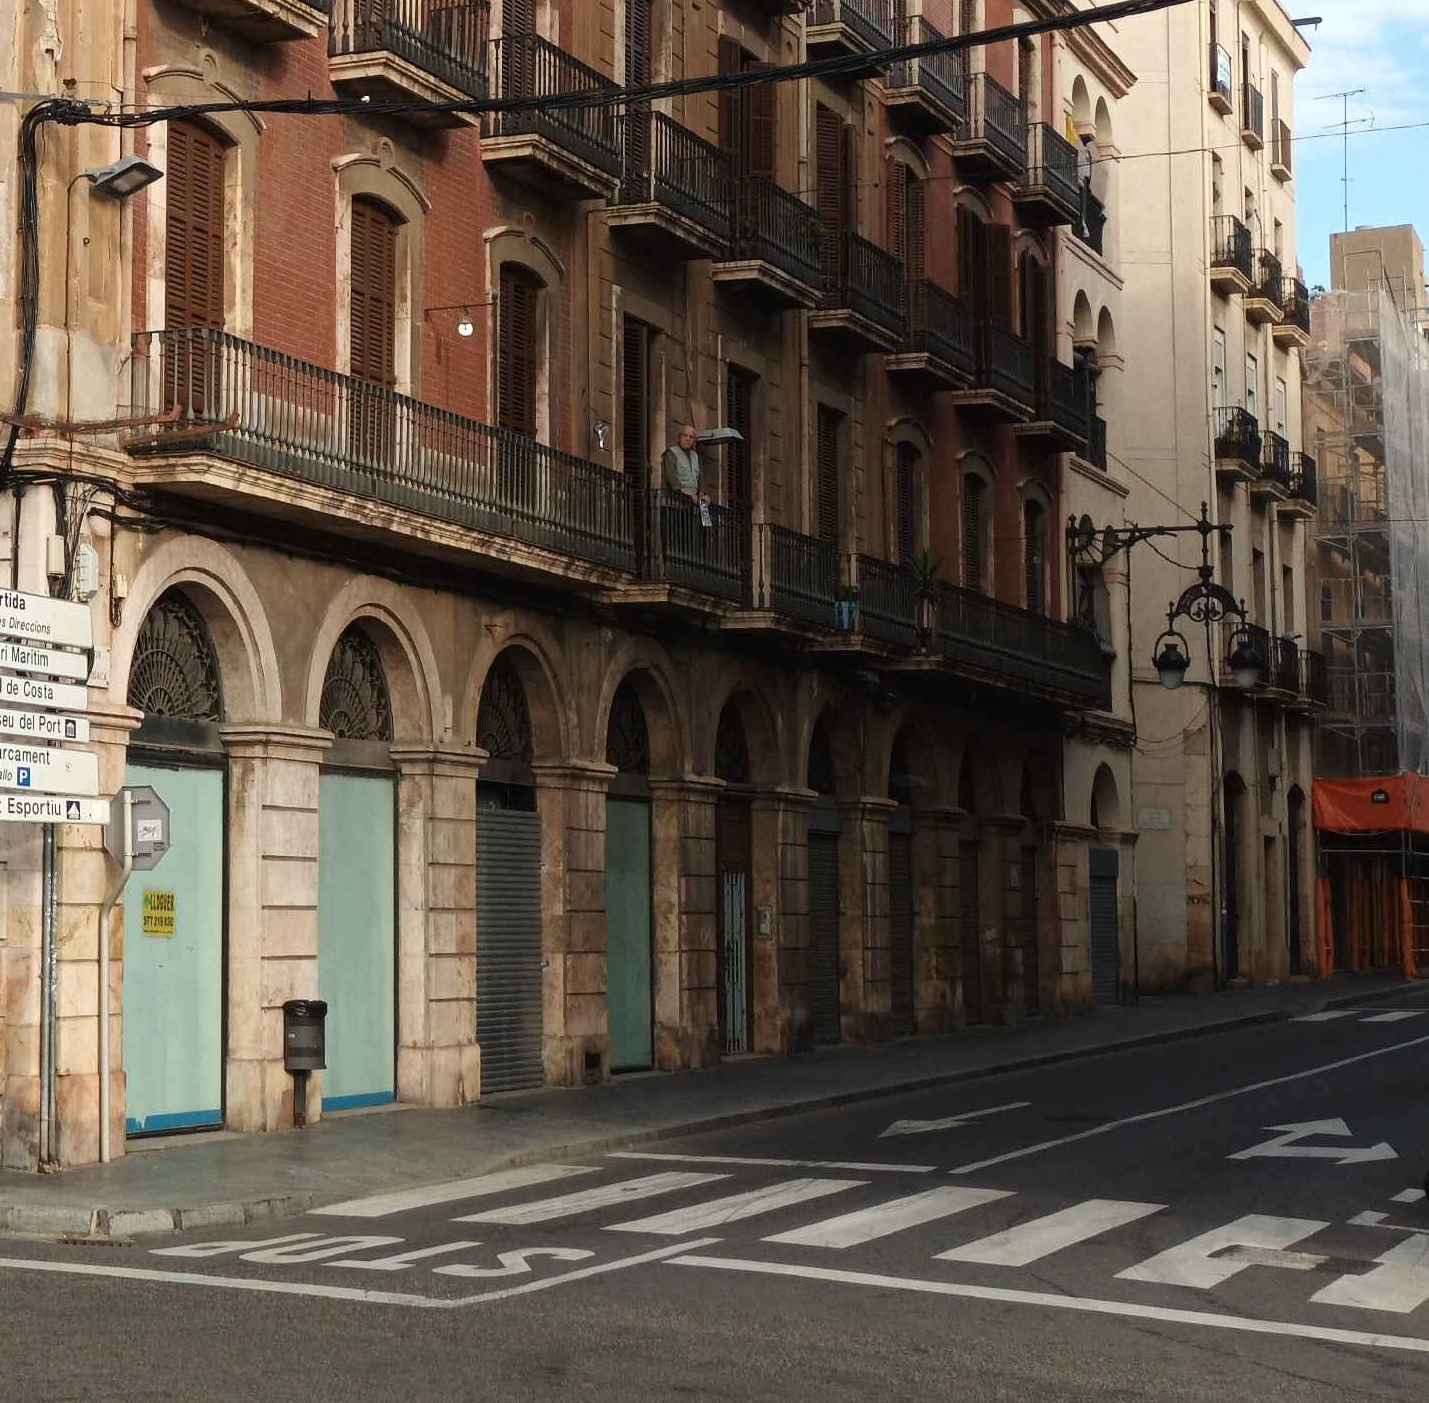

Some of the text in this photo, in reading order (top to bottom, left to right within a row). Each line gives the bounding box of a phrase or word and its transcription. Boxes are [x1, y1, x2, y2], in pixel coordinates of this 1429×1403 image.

[9, 617, 51, 635] Direccions
[11, 647, 49, 667] Marítim
[6, 678, 19, 695] de
[23, 681, 54, 700] Costa
[19, 713, 35, 730] del
[38, 715, 61, 734] Port
[7, 798, 61, 817] Esportiu
[147, 1233, 596, 1277] STOP
